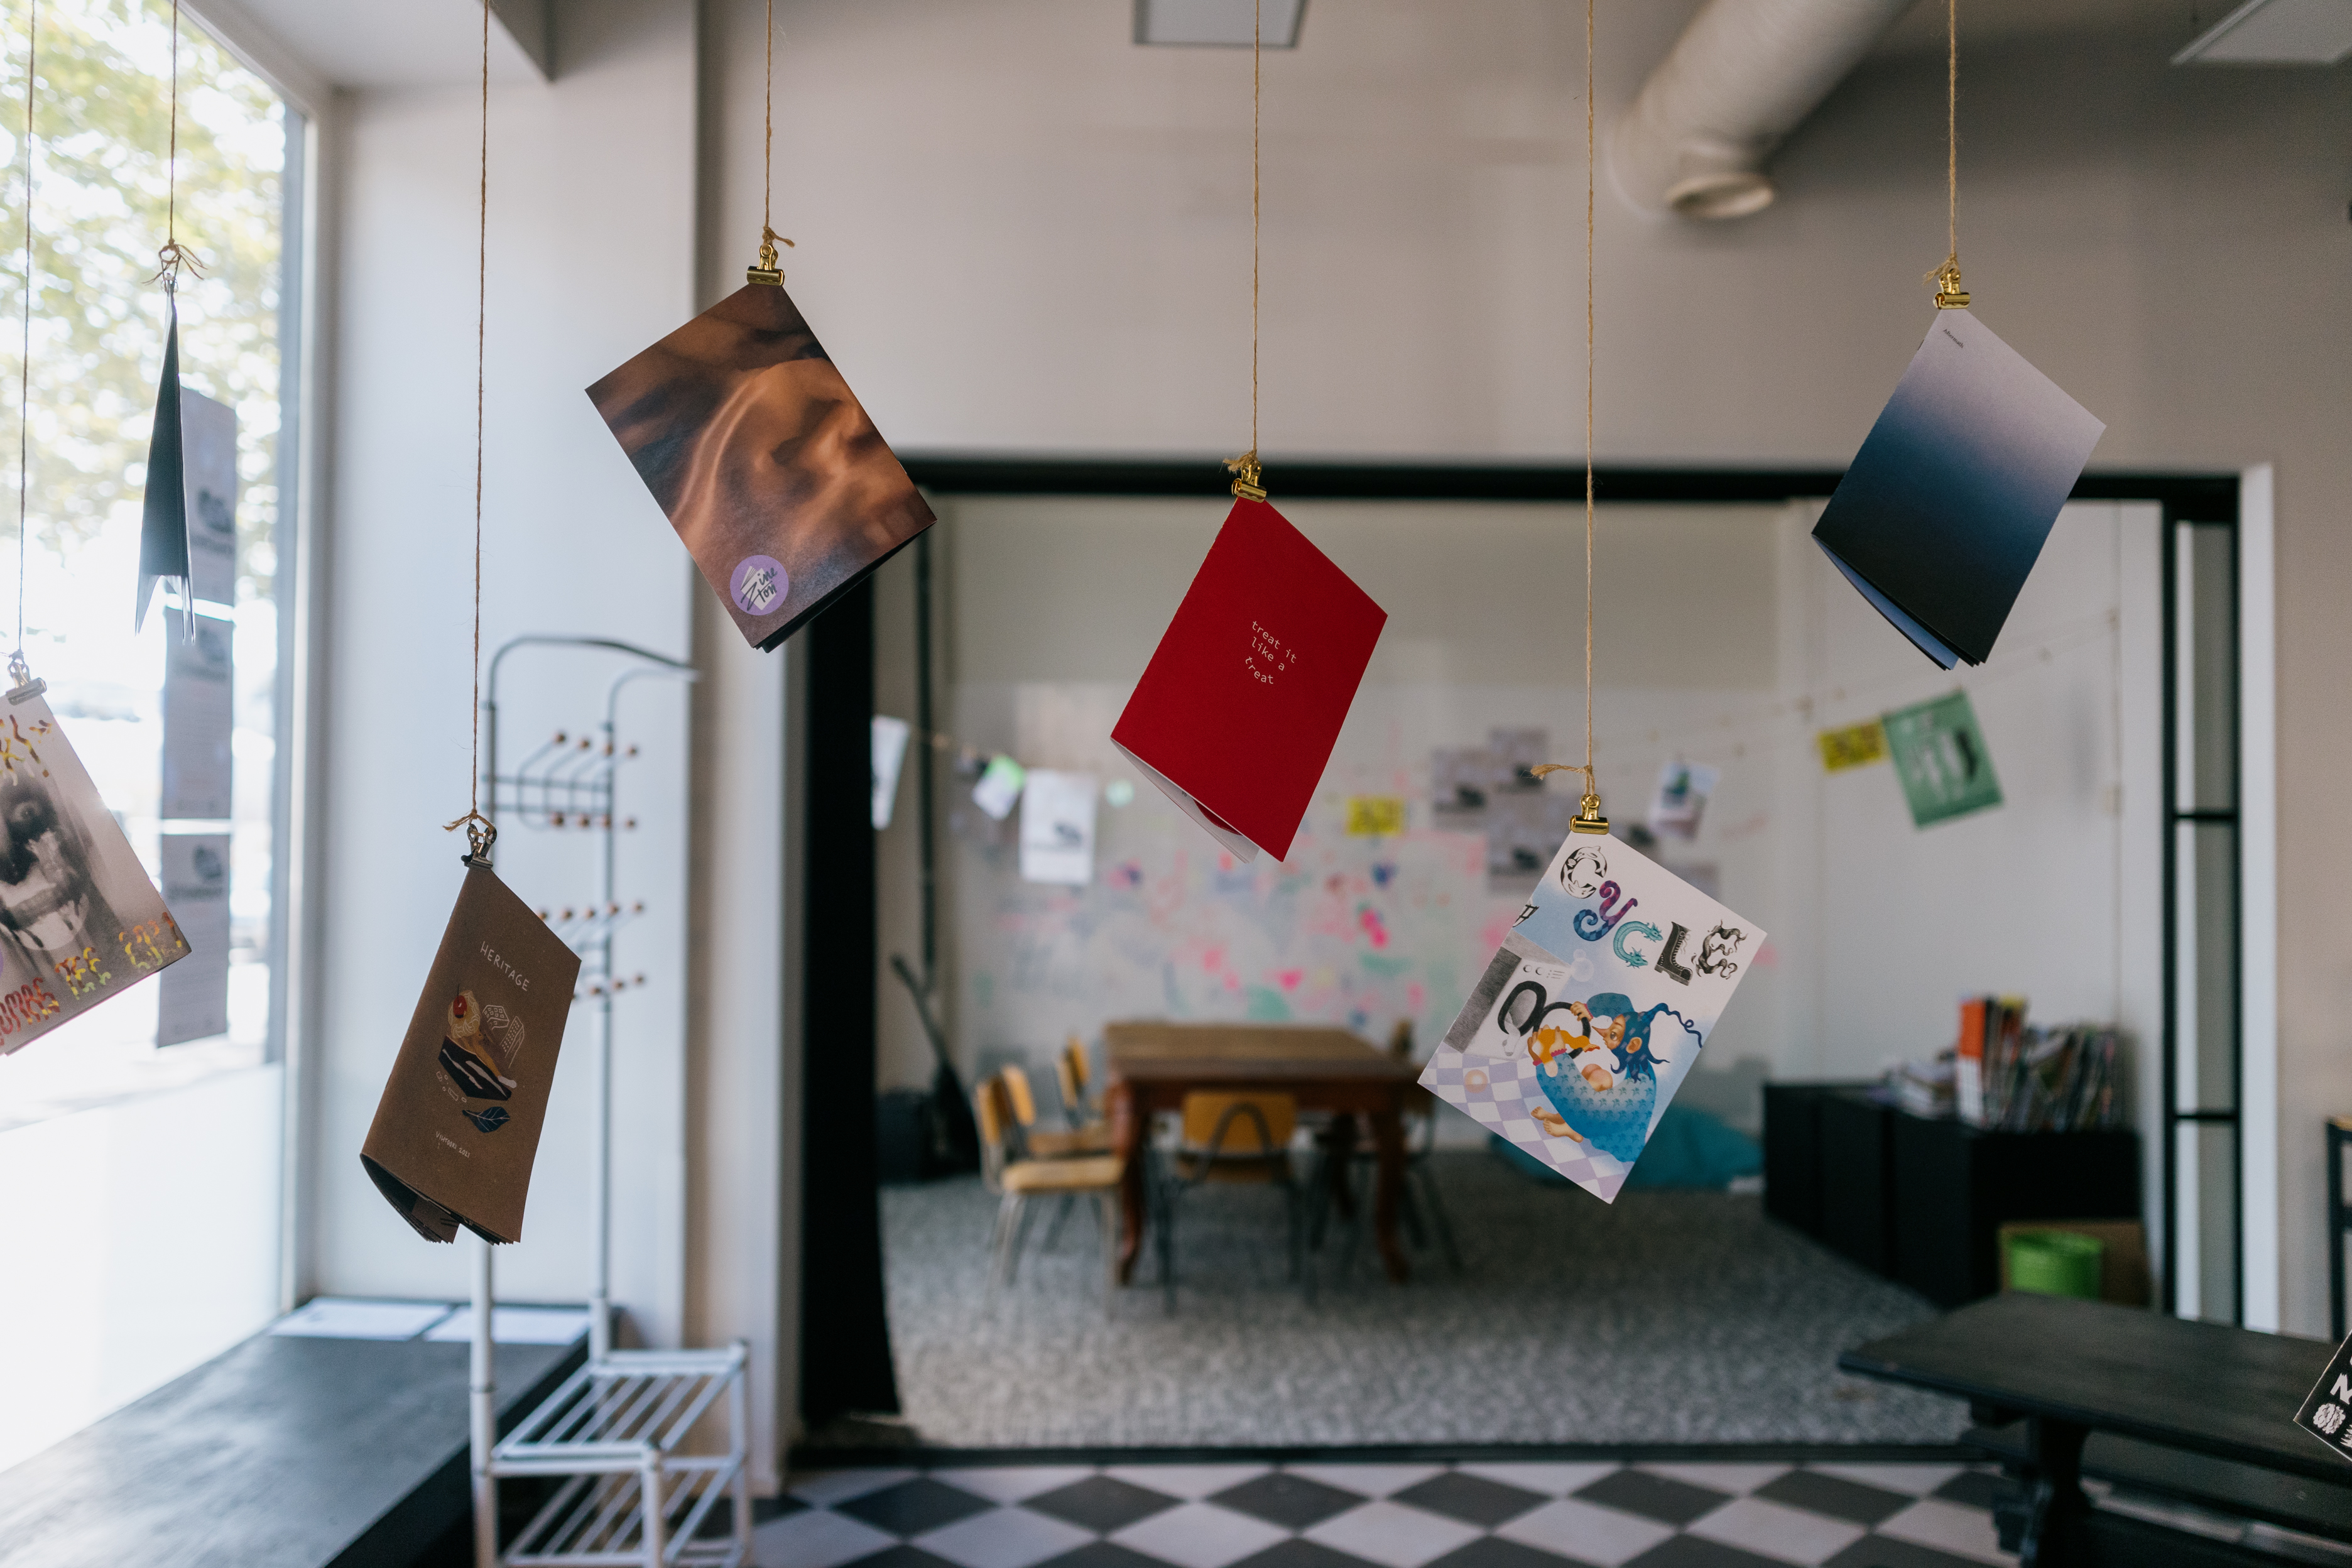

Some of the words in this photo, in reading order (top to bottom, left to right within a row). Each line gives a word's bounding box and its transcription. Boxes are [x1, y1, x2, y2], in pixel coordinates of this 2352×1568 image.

[1943, 329, 1964, 349] Aftermath
[1251, 636, 1274, 662] like
[1278, 663, 1285, 671] a
[1252, 621, 1280, 650] treat
[1286, 649, 1297, 663] it
[1245, 656, 1274, 684] treat
[1560, 846, 1748, 986] CYCLE
[480, 940, 530, 991] HERITAGE
[459, 1147, 471, 1158] 2021
